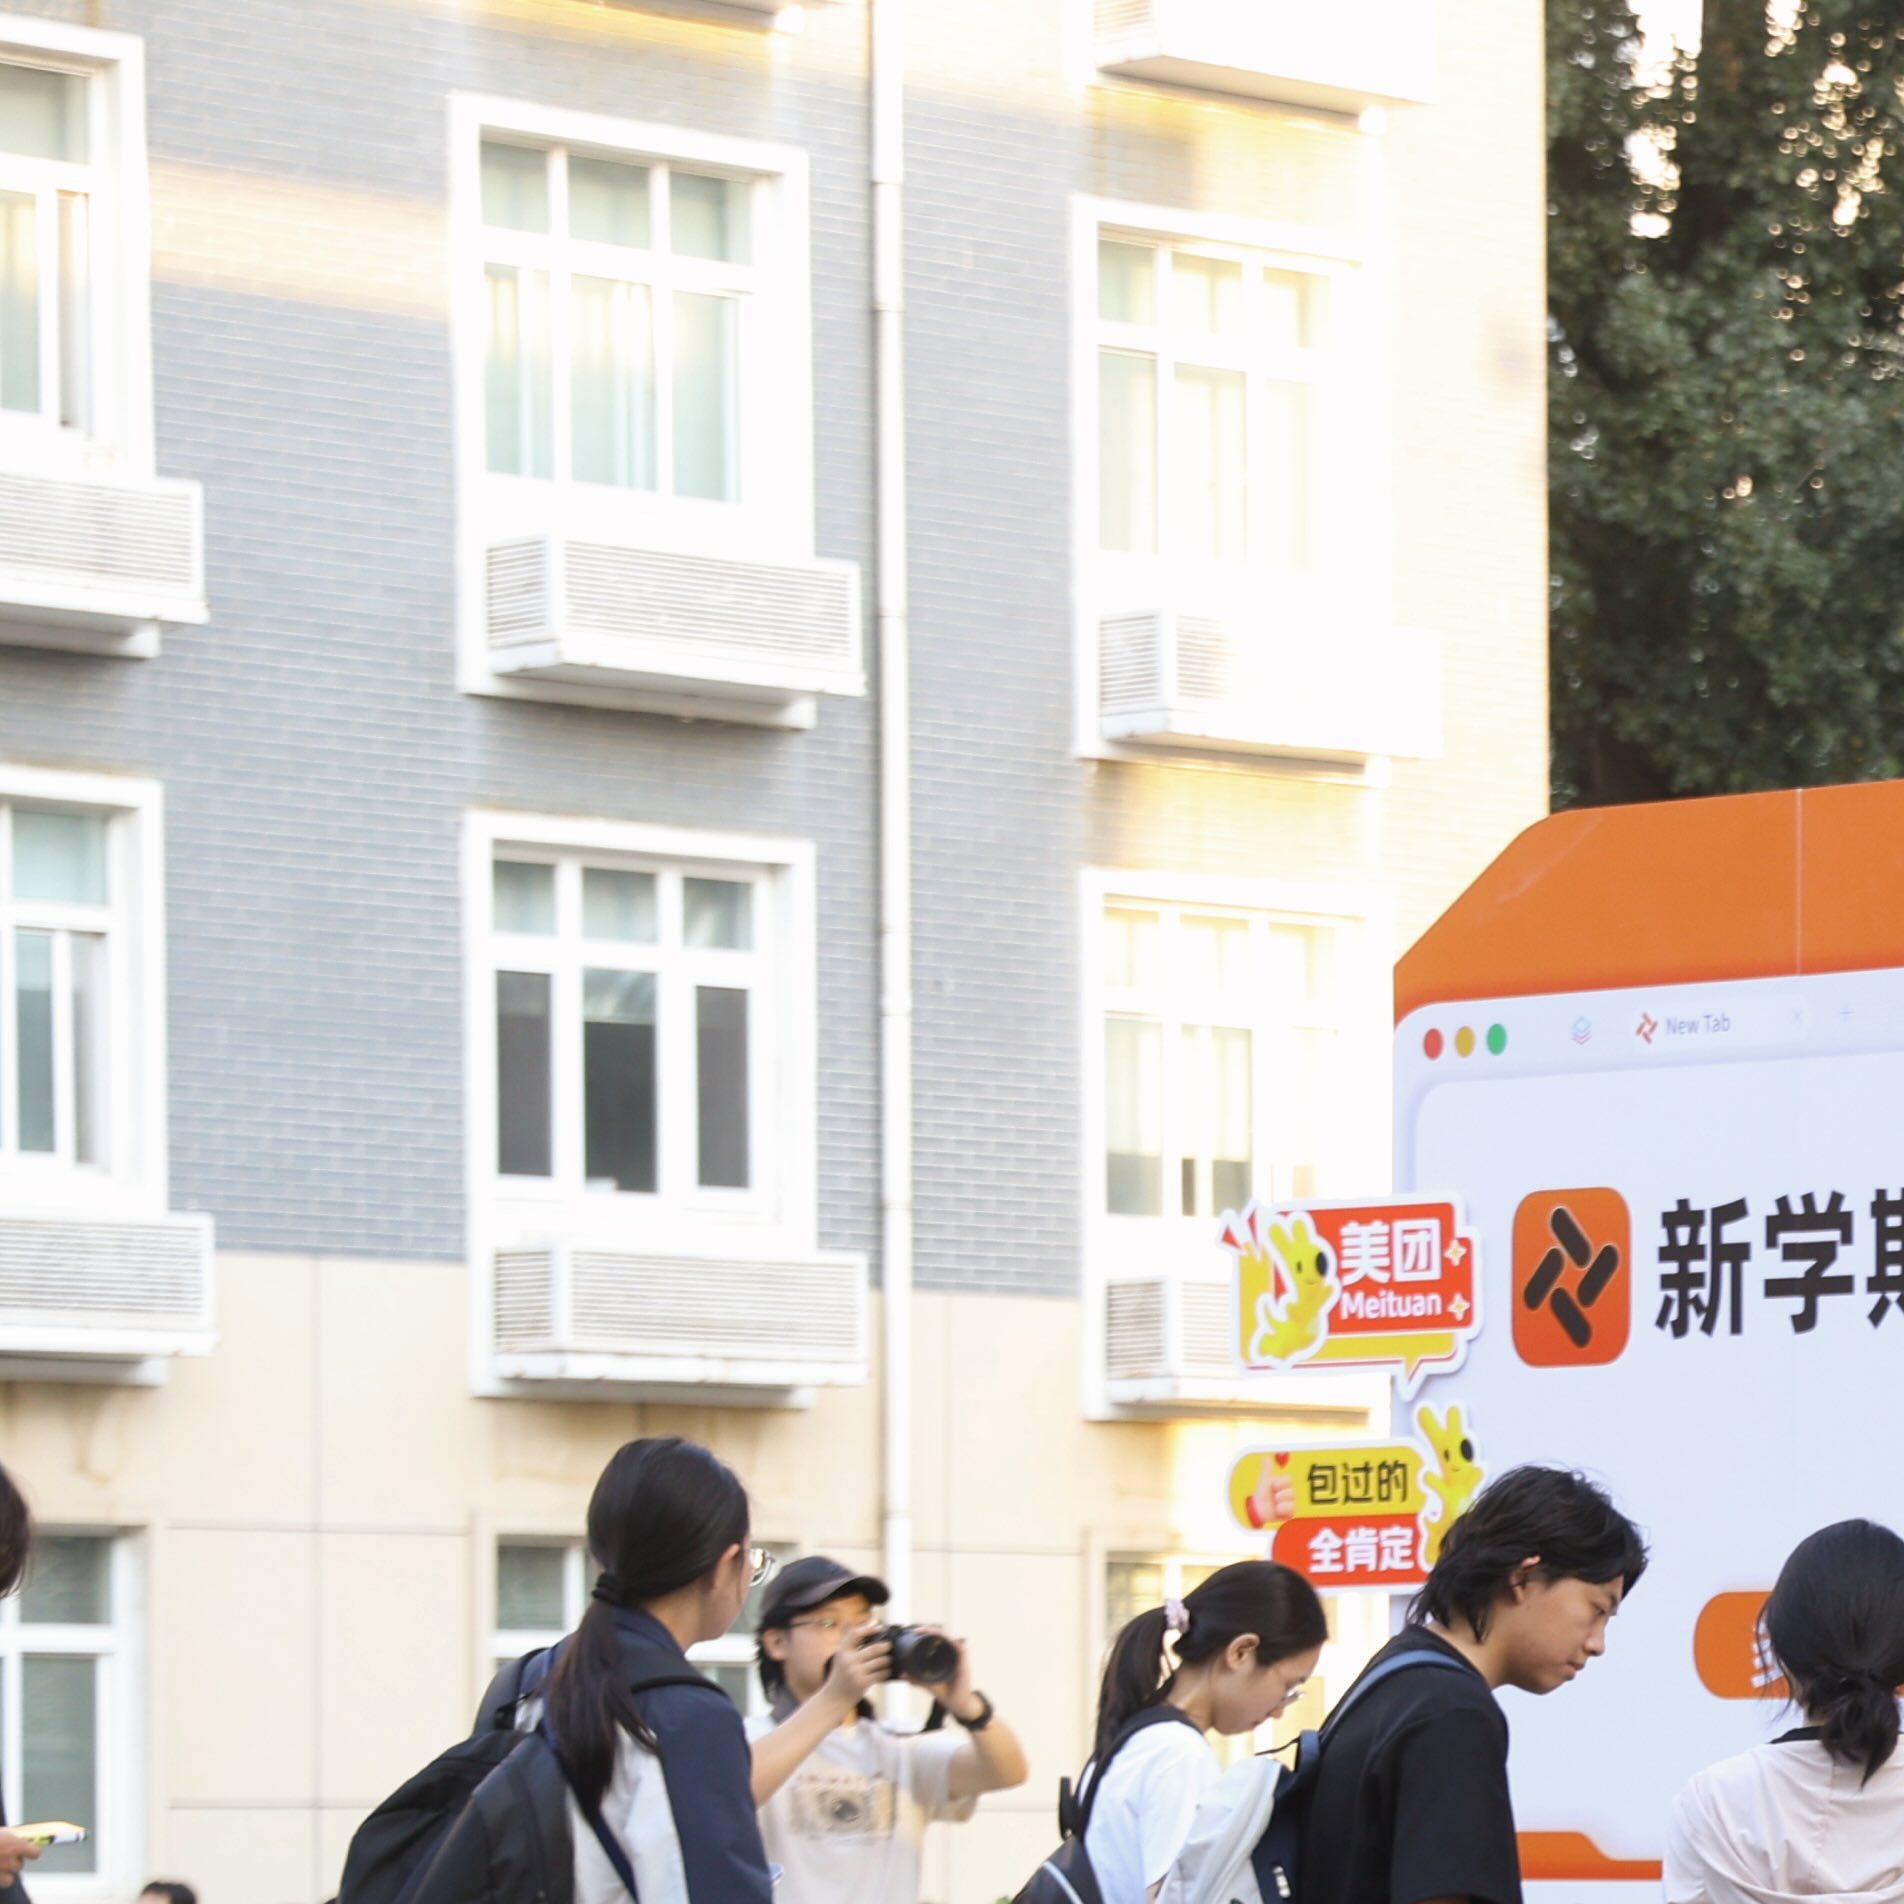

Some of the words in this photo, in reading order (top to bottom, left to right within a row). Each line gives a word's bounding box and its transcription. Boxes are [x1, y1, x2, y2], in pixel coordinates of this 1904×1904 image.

[1665, 1016, 1699, 1036] New
[1703, 1013, 1732, 1033] Tab
[1338, 1218, 1443, 1285] 美团
[1338, 1290, 1443, 1321] Meituan
[1308, 1459, 1409, 1505] 包过的
[1307, 1525, 1415, 1574] 全肯定
